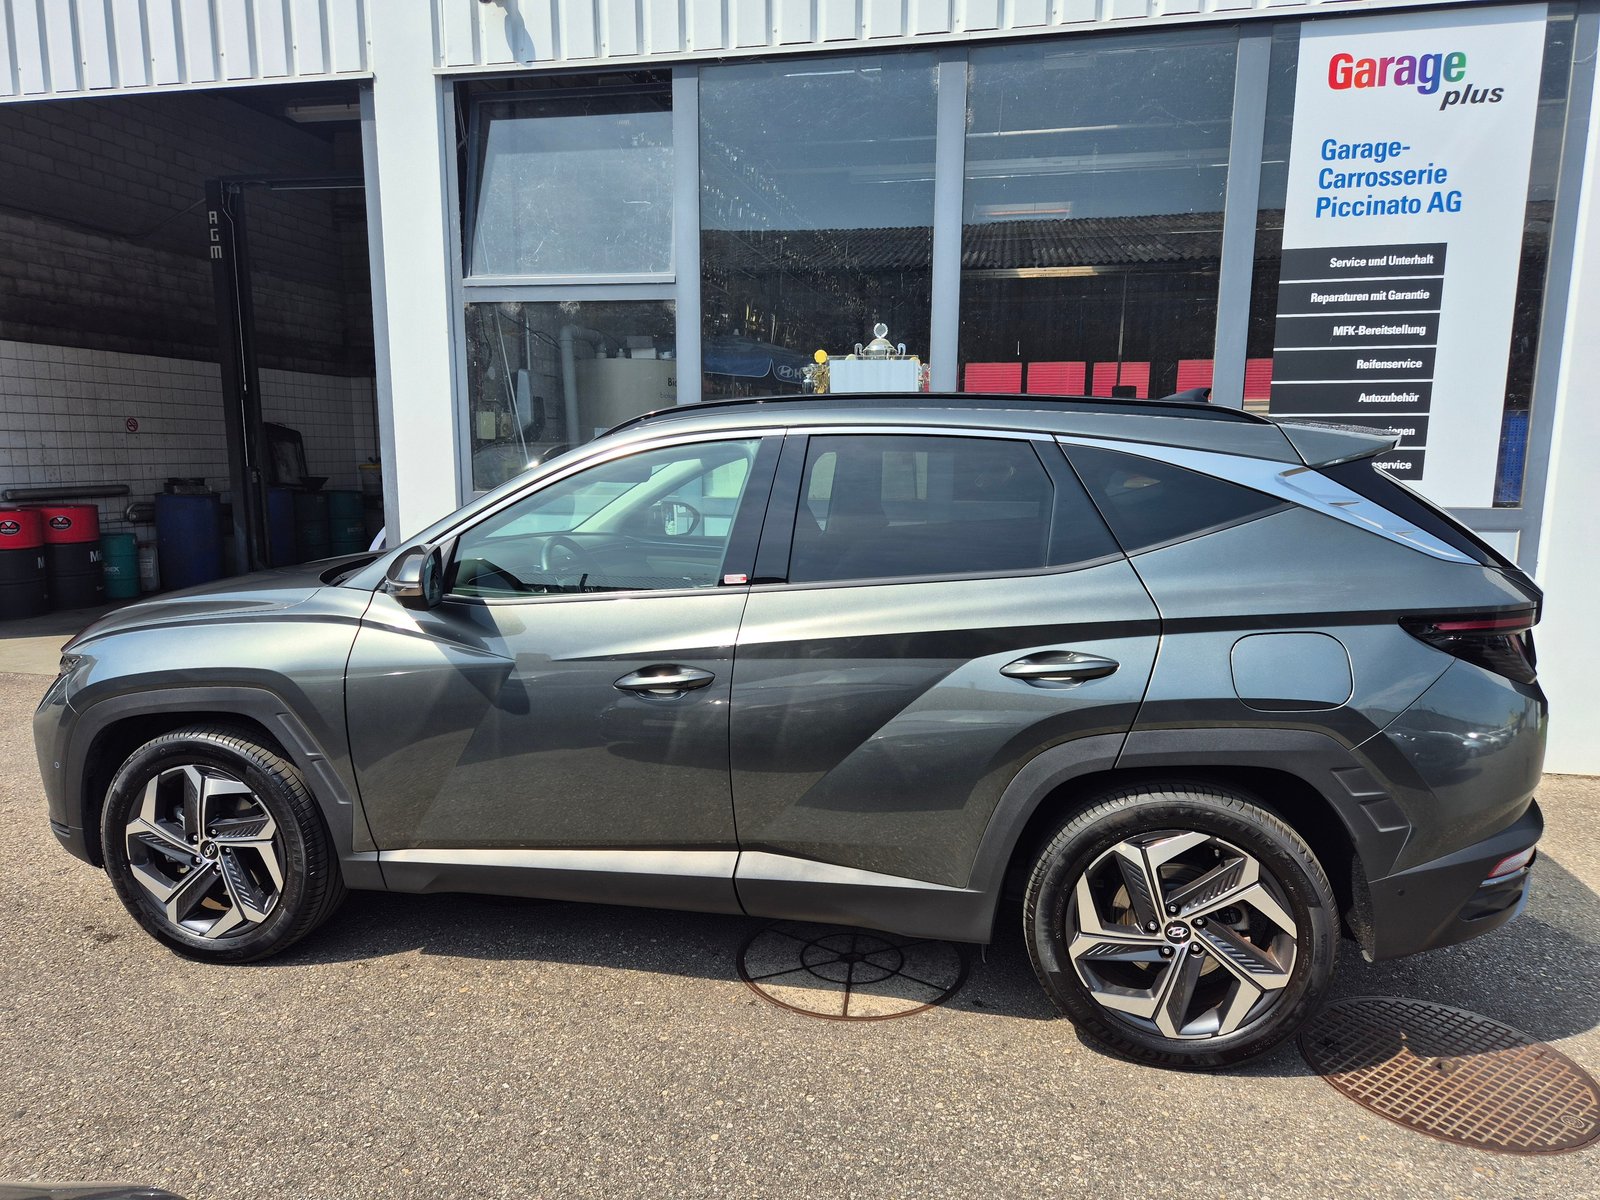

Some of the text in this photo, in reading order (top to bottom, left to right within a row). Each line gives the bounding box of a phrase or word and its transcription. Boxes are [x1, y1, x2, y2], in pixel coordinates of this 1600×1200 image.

[1328, 51, 1467, 95] Garage
[1439, 83, 1505, 111] plus
[1321, 138, 1411, 164] Garage-
[1318, 163, 1448, 190] Carrosserie
[1315, 190, 1462, 219] Piccinato AG
[1329, 254, 1434, 269] Service und Unterhalt
[1310, 289, 1430, 305] Reparaturen mit Garantie
[1332, 323, 1427, 337] MFK-Bereitstellung
[1356, 358, 1423, 370] Reifenservice
[1358, 392, 1420, 404] Autozubehör
